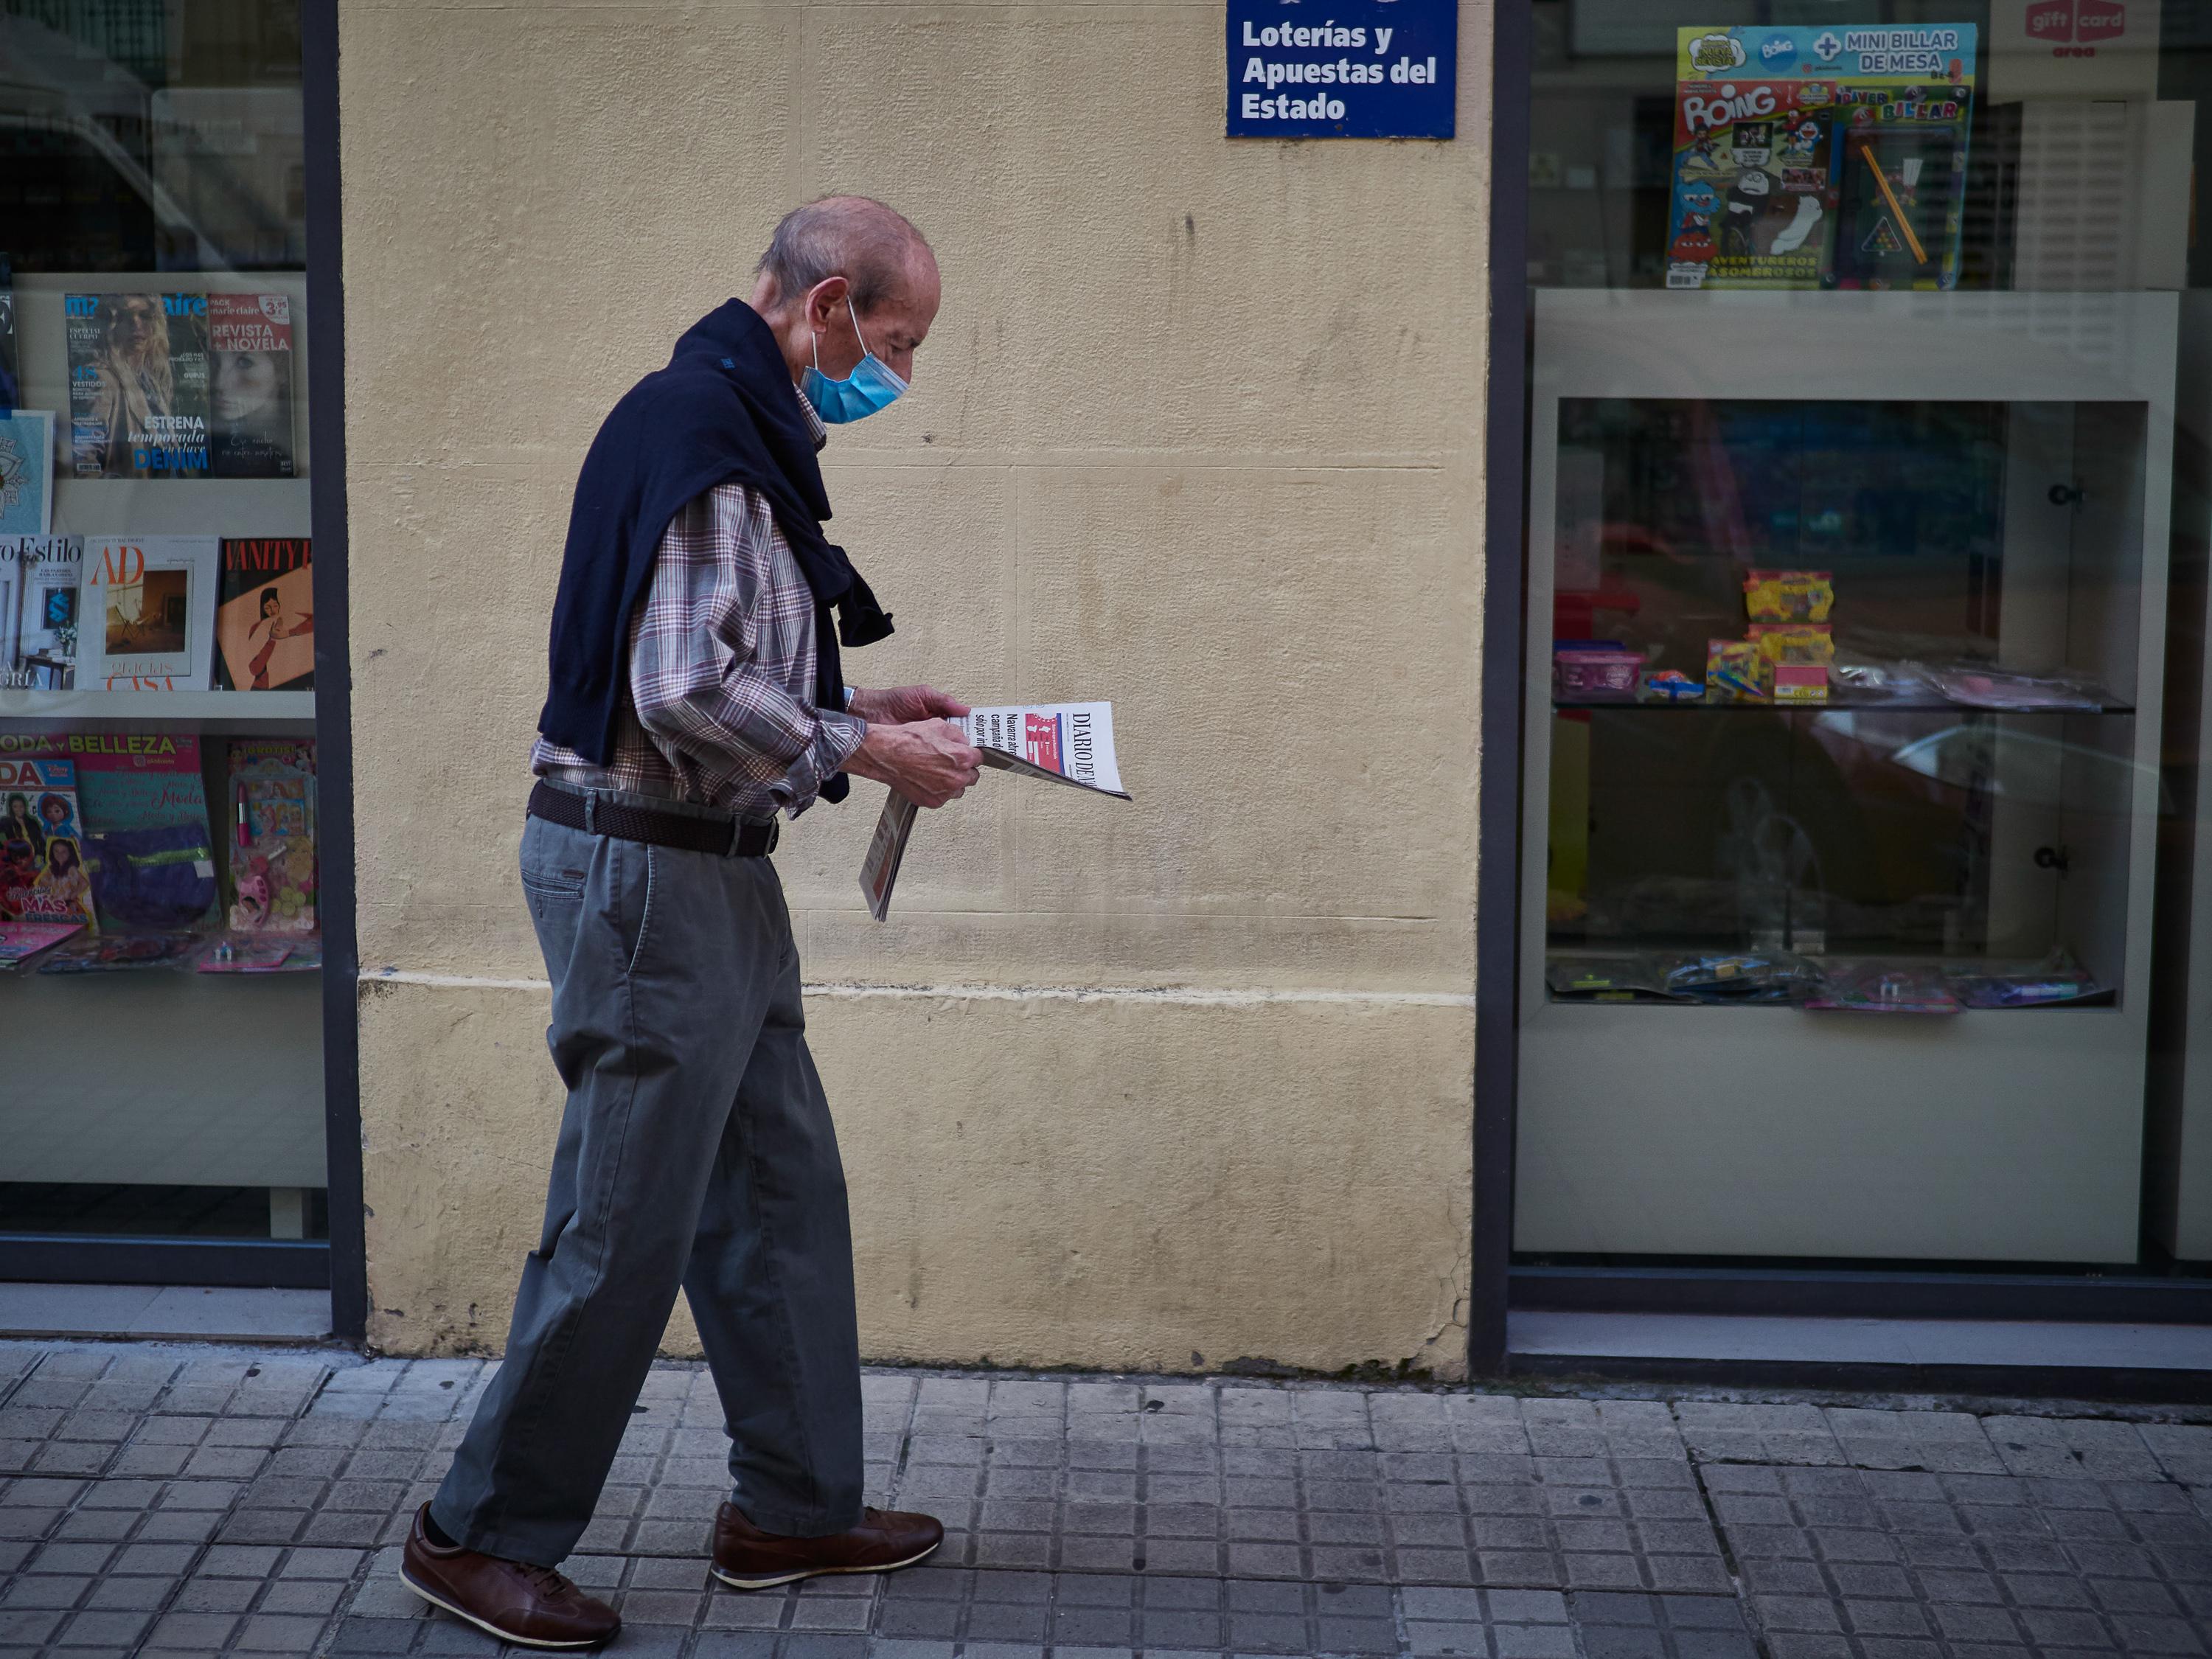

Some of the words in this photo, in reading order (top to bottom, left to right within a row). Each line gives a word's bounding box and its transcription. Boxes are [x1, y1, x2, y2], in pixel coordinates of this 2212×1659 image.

[2079, 12, 2122, 27] card
[1242, 20, 1366, 47] Loterías
[1374, 27, 1393, 55] y
[1847, 34, 1885, 49] MINI
[1891, 32, 1955, 48] BILLAR
[1862, 55, 1887, 69] DE
[1890, 55, 1940, 69] MESA
[1242, 58, 1383, 90] Apuestas
[1390, 56, 1436, 84] del
[1242, 92, 1346, 119] Estado
[1882, 101, 1958, 120] BILLAR
[210, 306, 234, 315] marie
[235, 306, 260, 315] claire
[212, 324, 273, 337] REVISTA
[226, 338, 289, 351] NOVELA
[143, 416, 204, 430] ESTRENA
[128, 428, 205, 447] temporada
[133, 448, 209, 470] DENIM
[19, 538, 82, 563] Estilo
[226, 540, 298, 570] VANITY
[90, 546, 145, 585] AD
[975, 714, 987, 727] sólo
[989, 714, 1003, 742] campaña
[1006, 714, 1018, 741] Navarra
[974, 727, 985, 737] por
[1072, 712, 1094, 760] DIARIO
[68, 734, 177, 755] BELLEZA
[1007, 742, 1019, 755] abre
[1075, 762, 1095, 776] DE
[150, 789, 202, 810] Moda
[21, 894, 68, 914] MÁS
